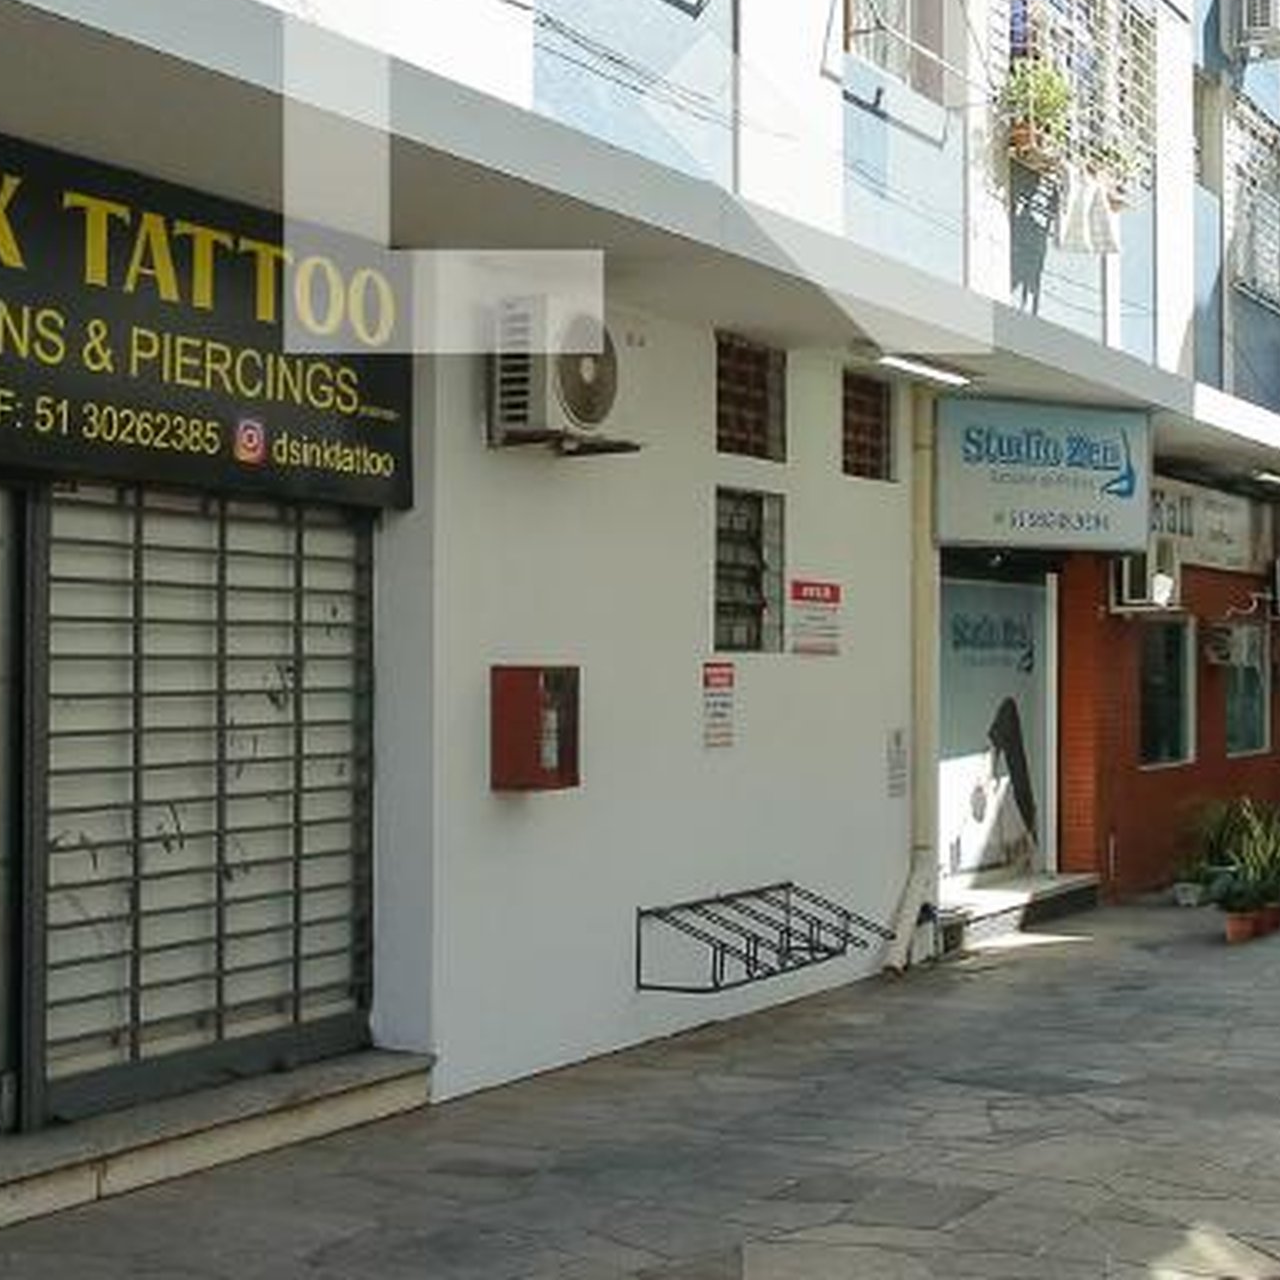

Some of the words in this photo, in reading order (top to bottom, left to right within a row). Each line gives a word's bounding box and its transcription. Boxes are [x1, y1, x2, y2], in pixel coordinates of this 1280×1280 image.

[63, 190, 396, 347] TATTOO
[81, 317, 115, 375] &
[129, 324, 360, 416] PIERCINGS
[34, 394, 70, 435] 51
[81, 400, 221, 455] 30262385
[272, 431, 396, 477] dsinktattoo
